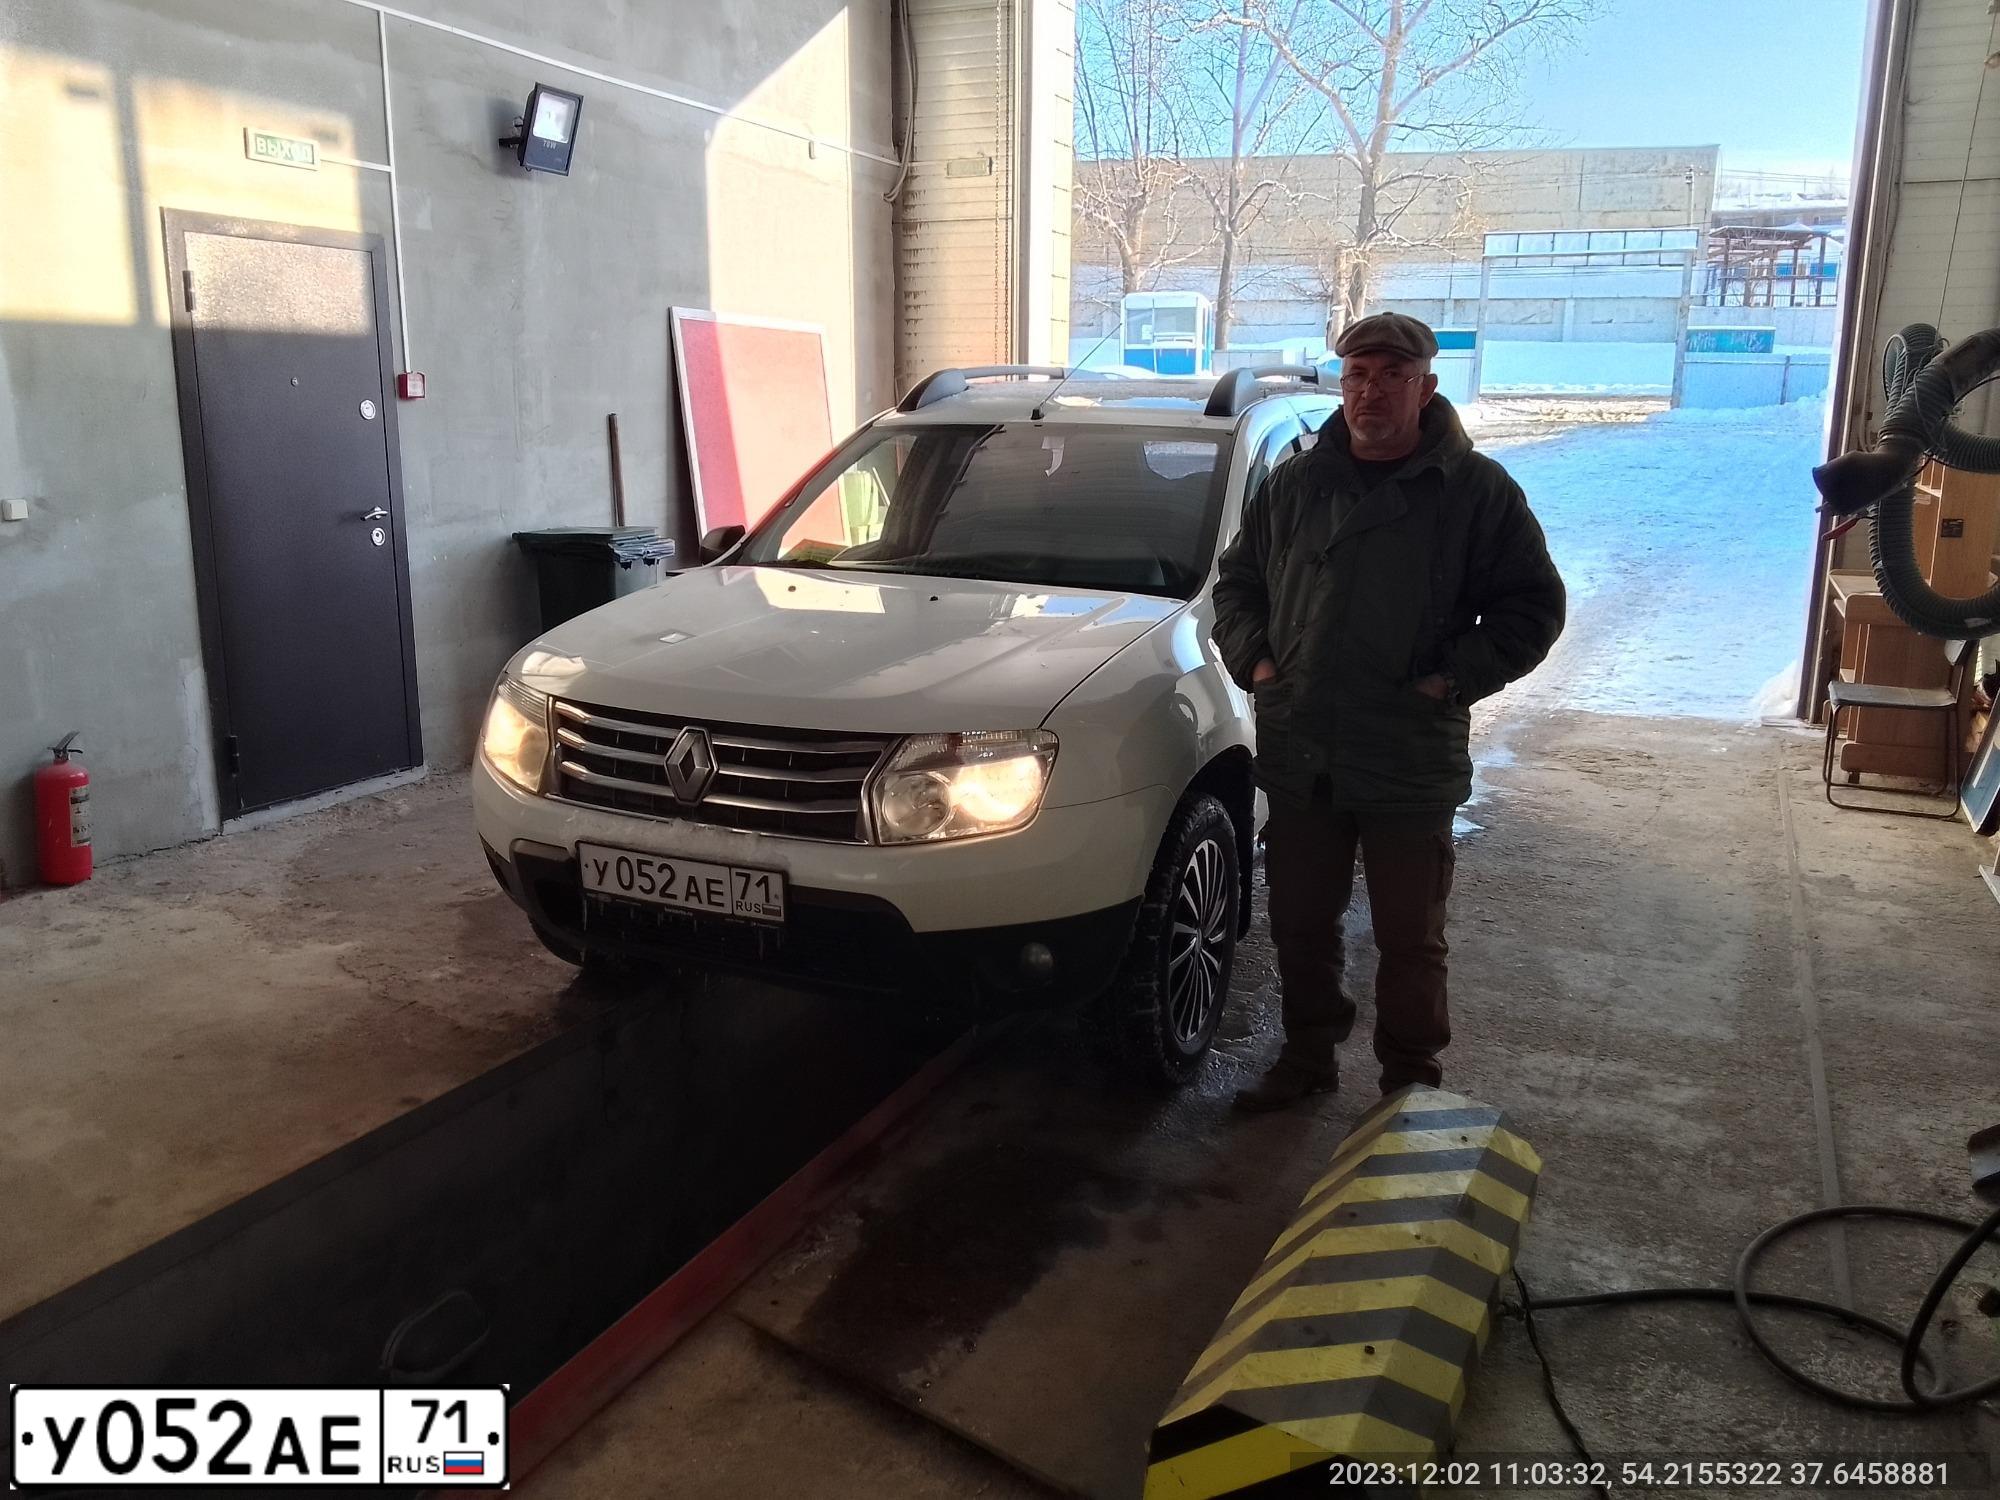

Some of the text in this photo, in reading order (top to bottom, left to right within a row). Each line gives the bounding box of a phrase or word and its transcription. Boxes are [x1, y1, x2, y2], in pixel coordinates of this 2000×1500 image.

[593, 856, 771, 907] У052АЕ 71
[735, 901, 761, 913] RUS
